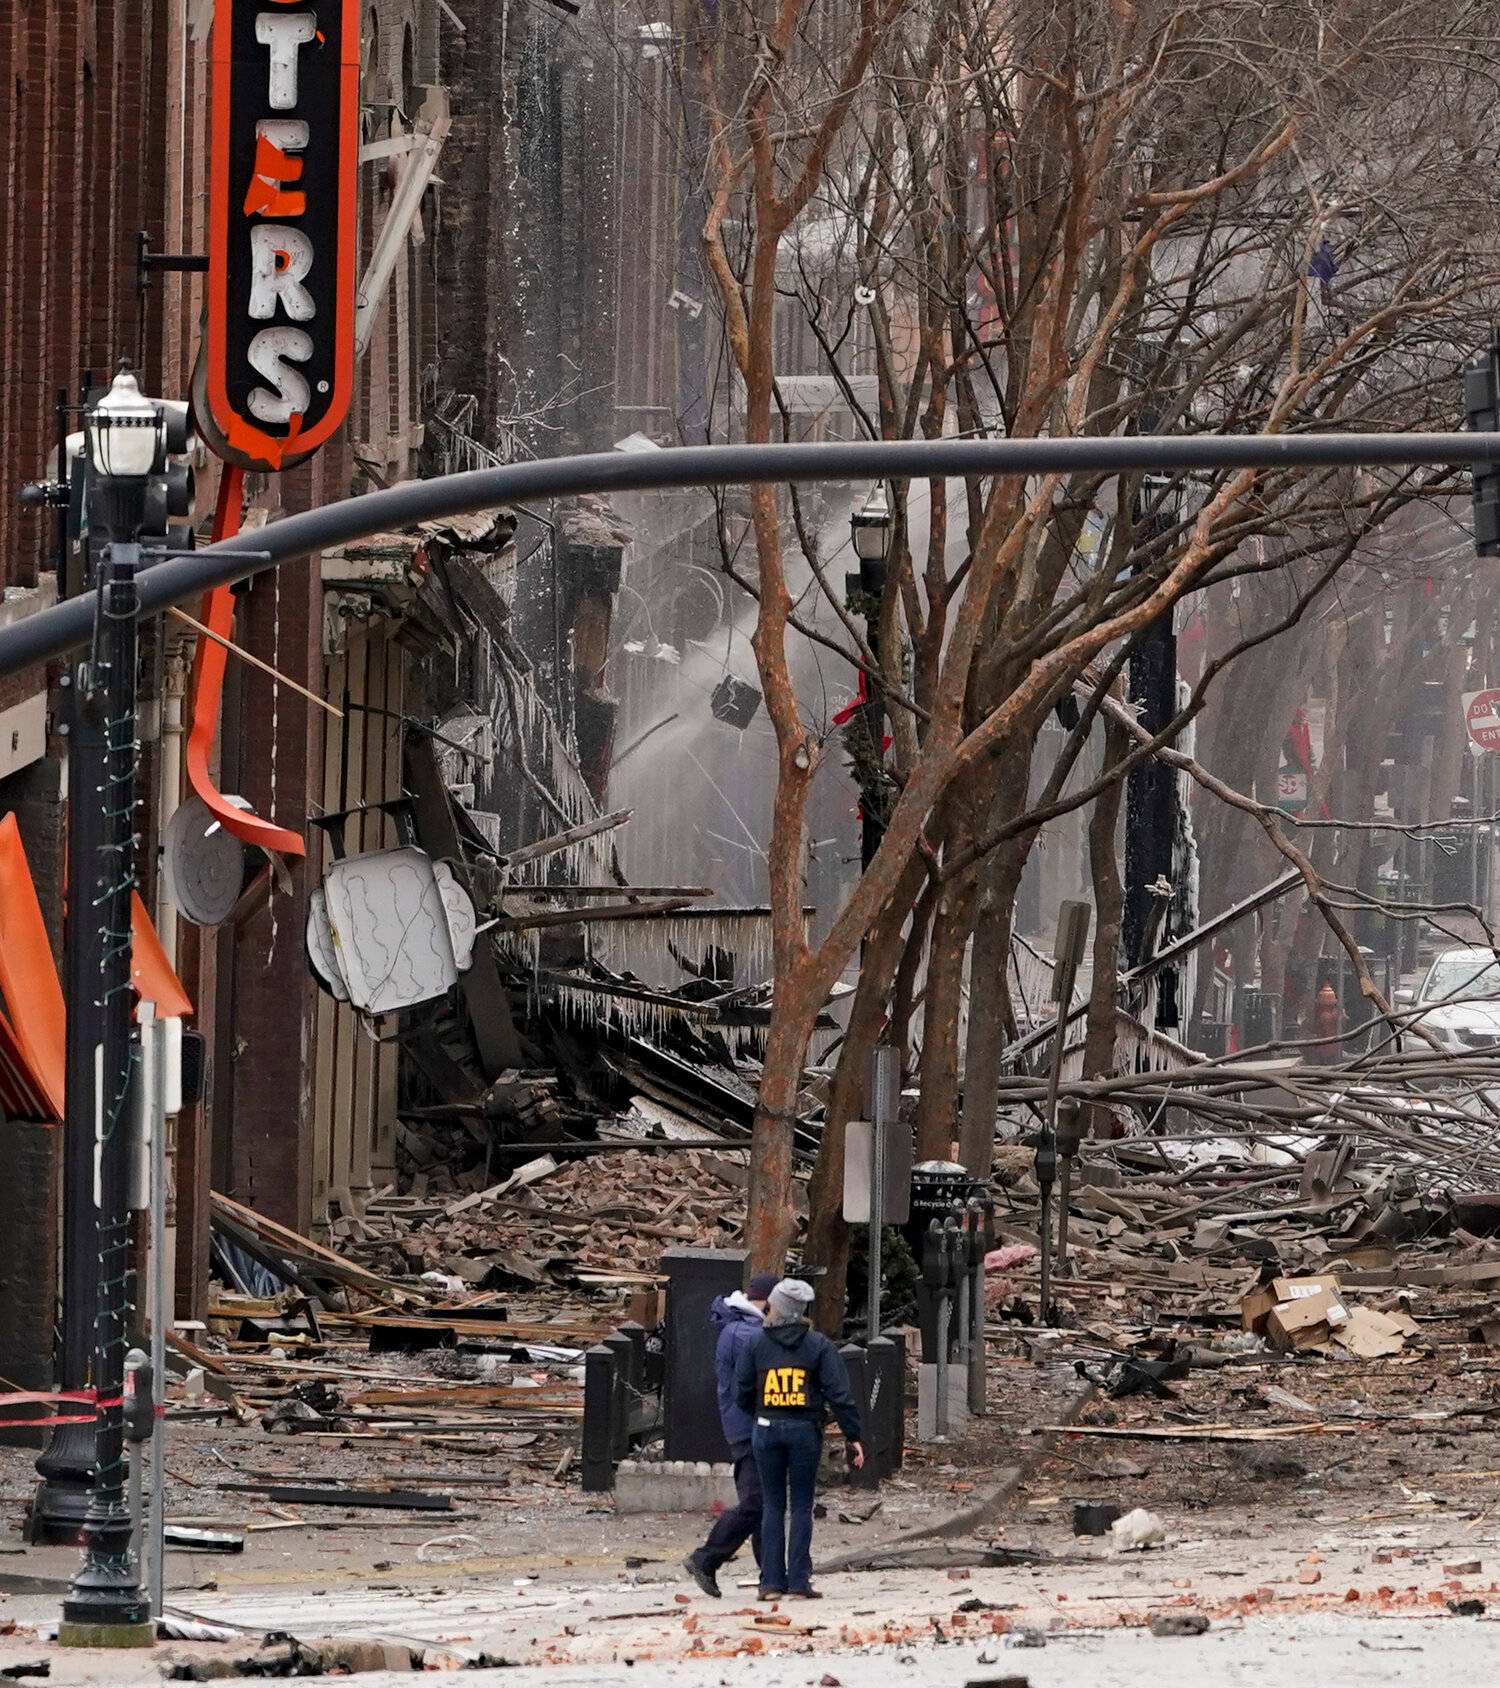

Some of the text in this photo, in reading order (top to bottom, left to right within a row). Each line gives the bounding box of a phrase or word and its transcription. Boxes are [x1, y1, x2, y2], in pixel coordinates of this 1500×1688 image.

[246, 0, 318, 424] TERS
[1472, 703, 1489, 715] DO
[919, 1200, 946, 1209] Recycle
[763, 1367, 806, 1394] ATF
[763, 1393, 806, 1407] POLICE
